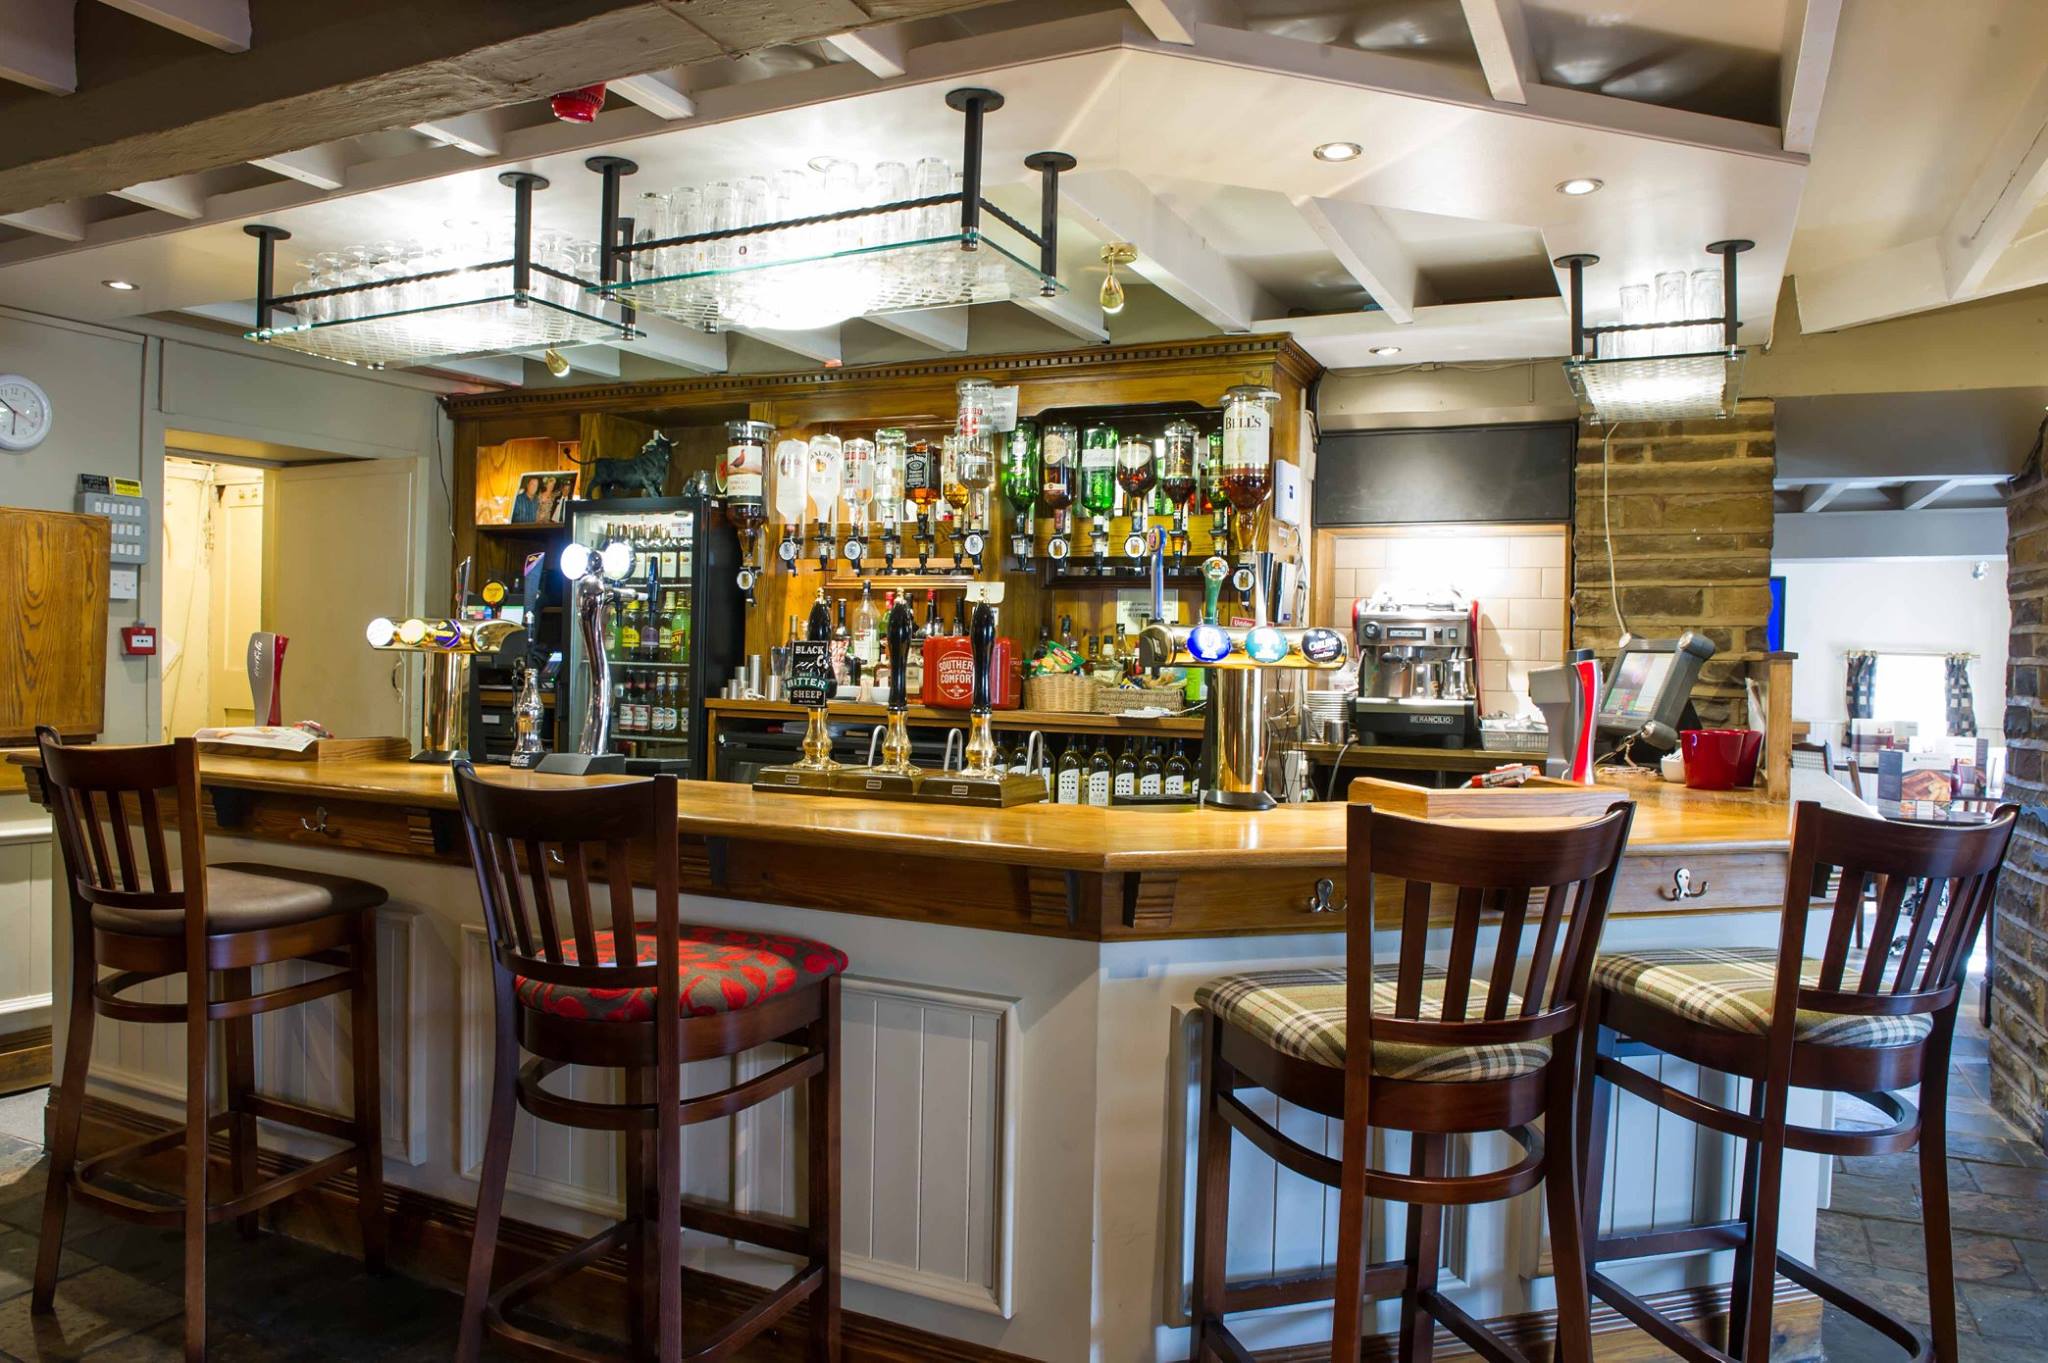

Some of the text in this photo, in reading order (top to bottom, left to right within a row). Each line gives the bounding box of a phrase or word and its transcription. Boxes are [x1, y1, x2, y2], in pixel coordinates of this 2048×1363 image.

[1225, 415, 1262, 431] BELL'S
[795, 645, 824, 655] BLACK
[938, 659, 973, 673] SOUTHER
[786, 677, 826, 689] BITTER
[793, 690, 822, 699] SHEEP
